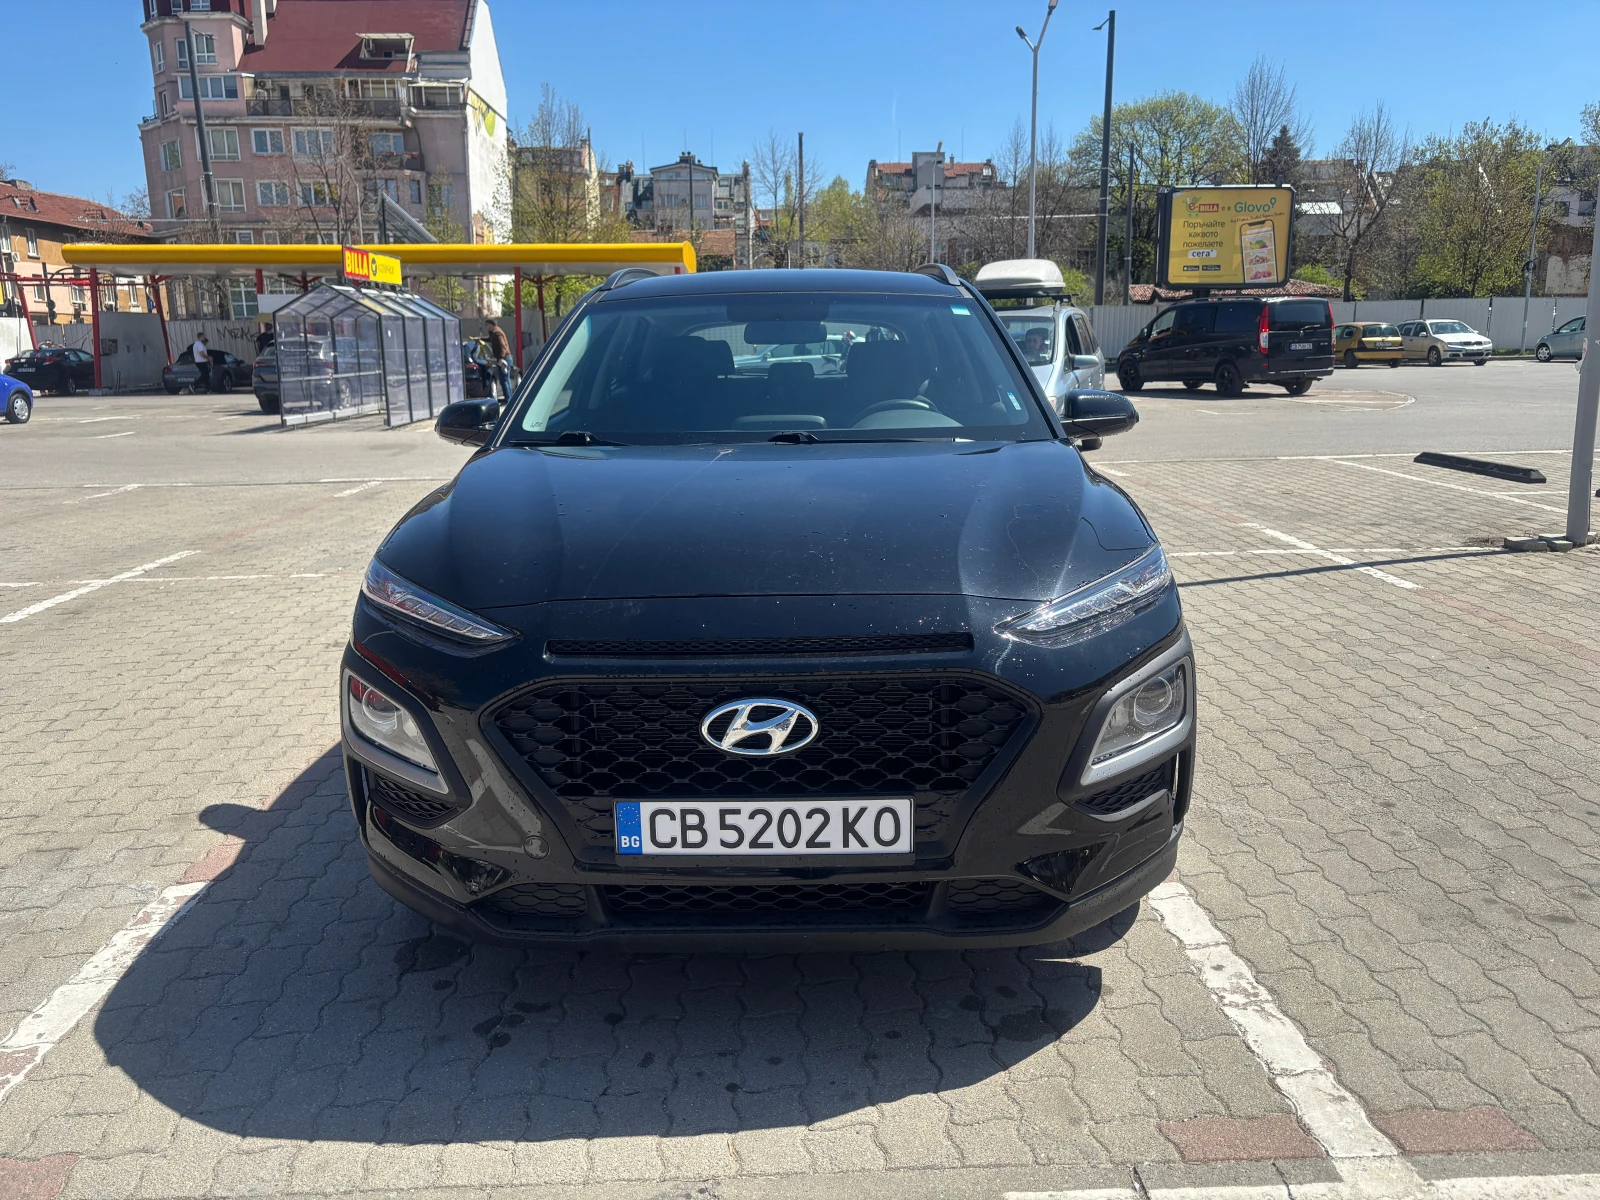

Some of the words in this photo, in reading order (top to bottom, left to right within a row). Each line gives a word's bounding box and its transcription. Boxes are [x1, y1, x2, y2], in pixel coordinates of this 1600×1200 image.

[1234, 202, 1270, 212] Glovo
[1183, 220, 1225, 230] Поръчайте
[345, 250, 368, 276] BILLA
[649, 808, 708, 849] CB
[718, 808, 831, 849] 5202
[620, 836, 640, 848] BG
